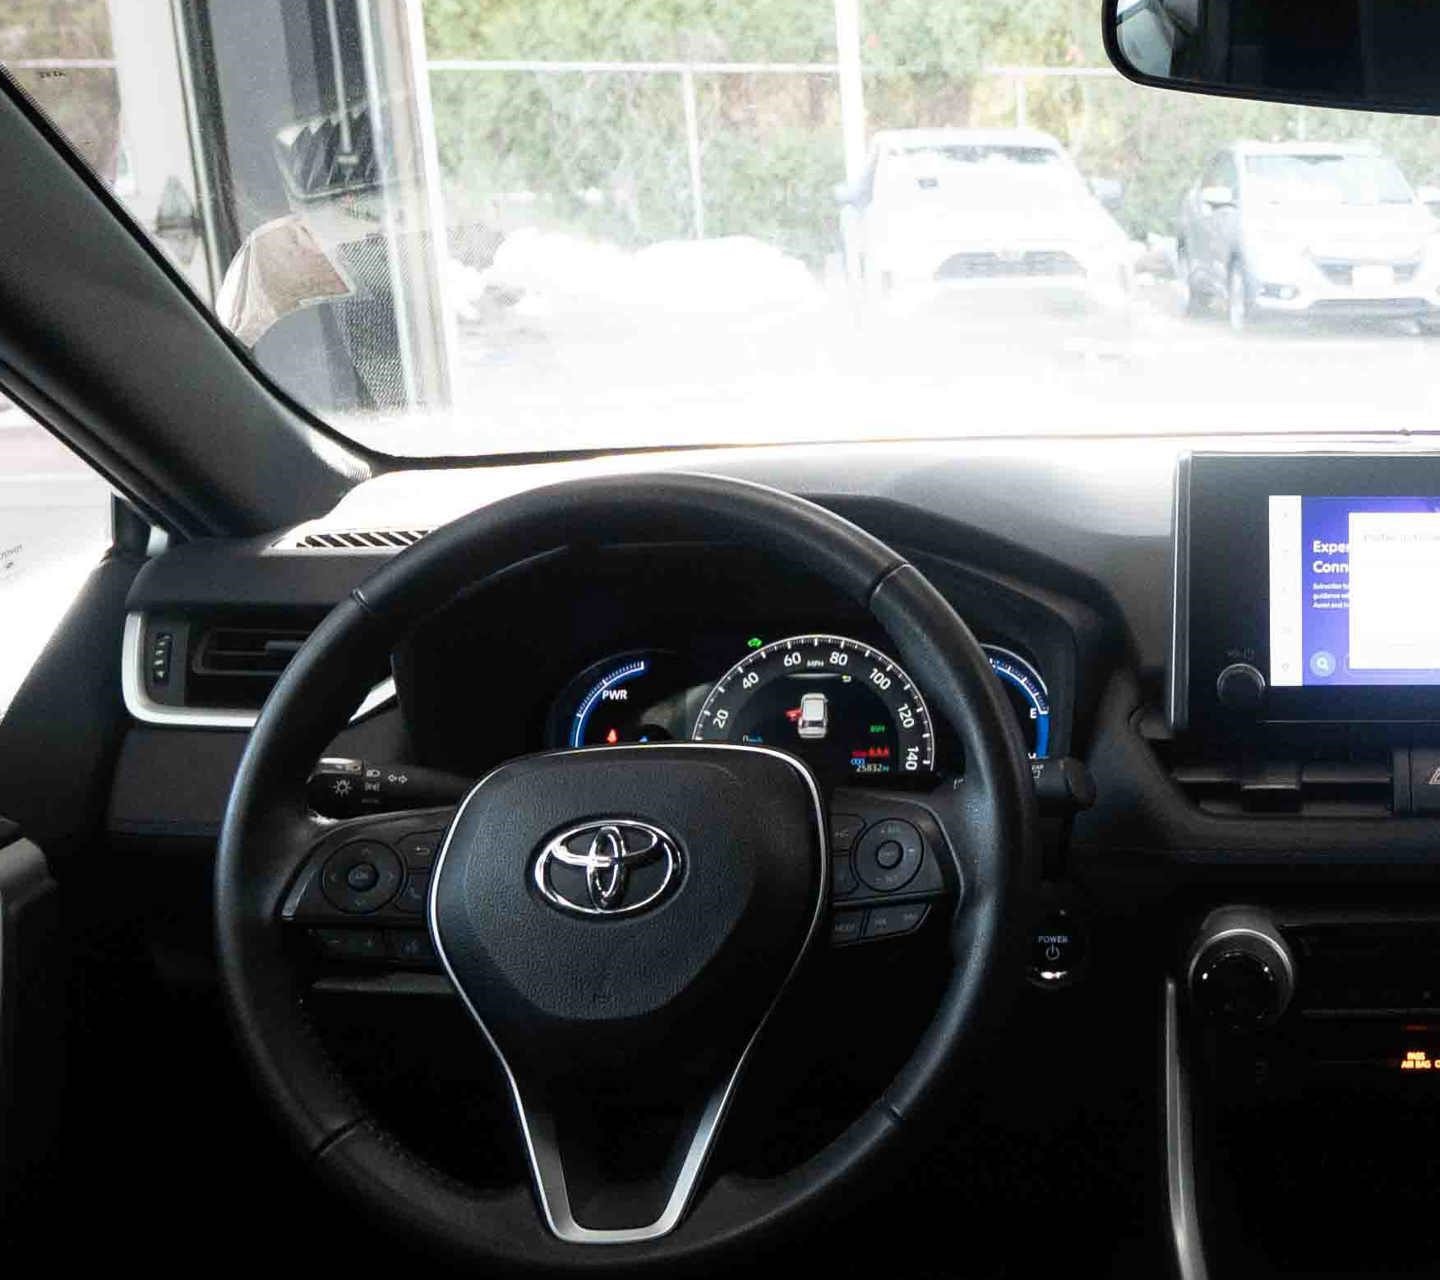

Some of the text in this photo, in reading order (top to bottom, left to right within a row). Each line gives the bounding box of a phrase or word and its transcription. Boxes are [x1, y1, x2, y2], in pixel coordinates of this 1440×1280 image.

[783, 651, 801, 667] 60
[806, 659, 824, 667] MPH
[829, 650, 848, 666] 80
[742, 672, 759, 689] 40
[869, 668, 891, 690] 100
[602, 689, 628, 700] PWR
[713, 709, 729, 729] 20
[898, 703, 915, 728] 120
[1029, 707, 1038, 719] E
[905, 746, 920, 771] 140
